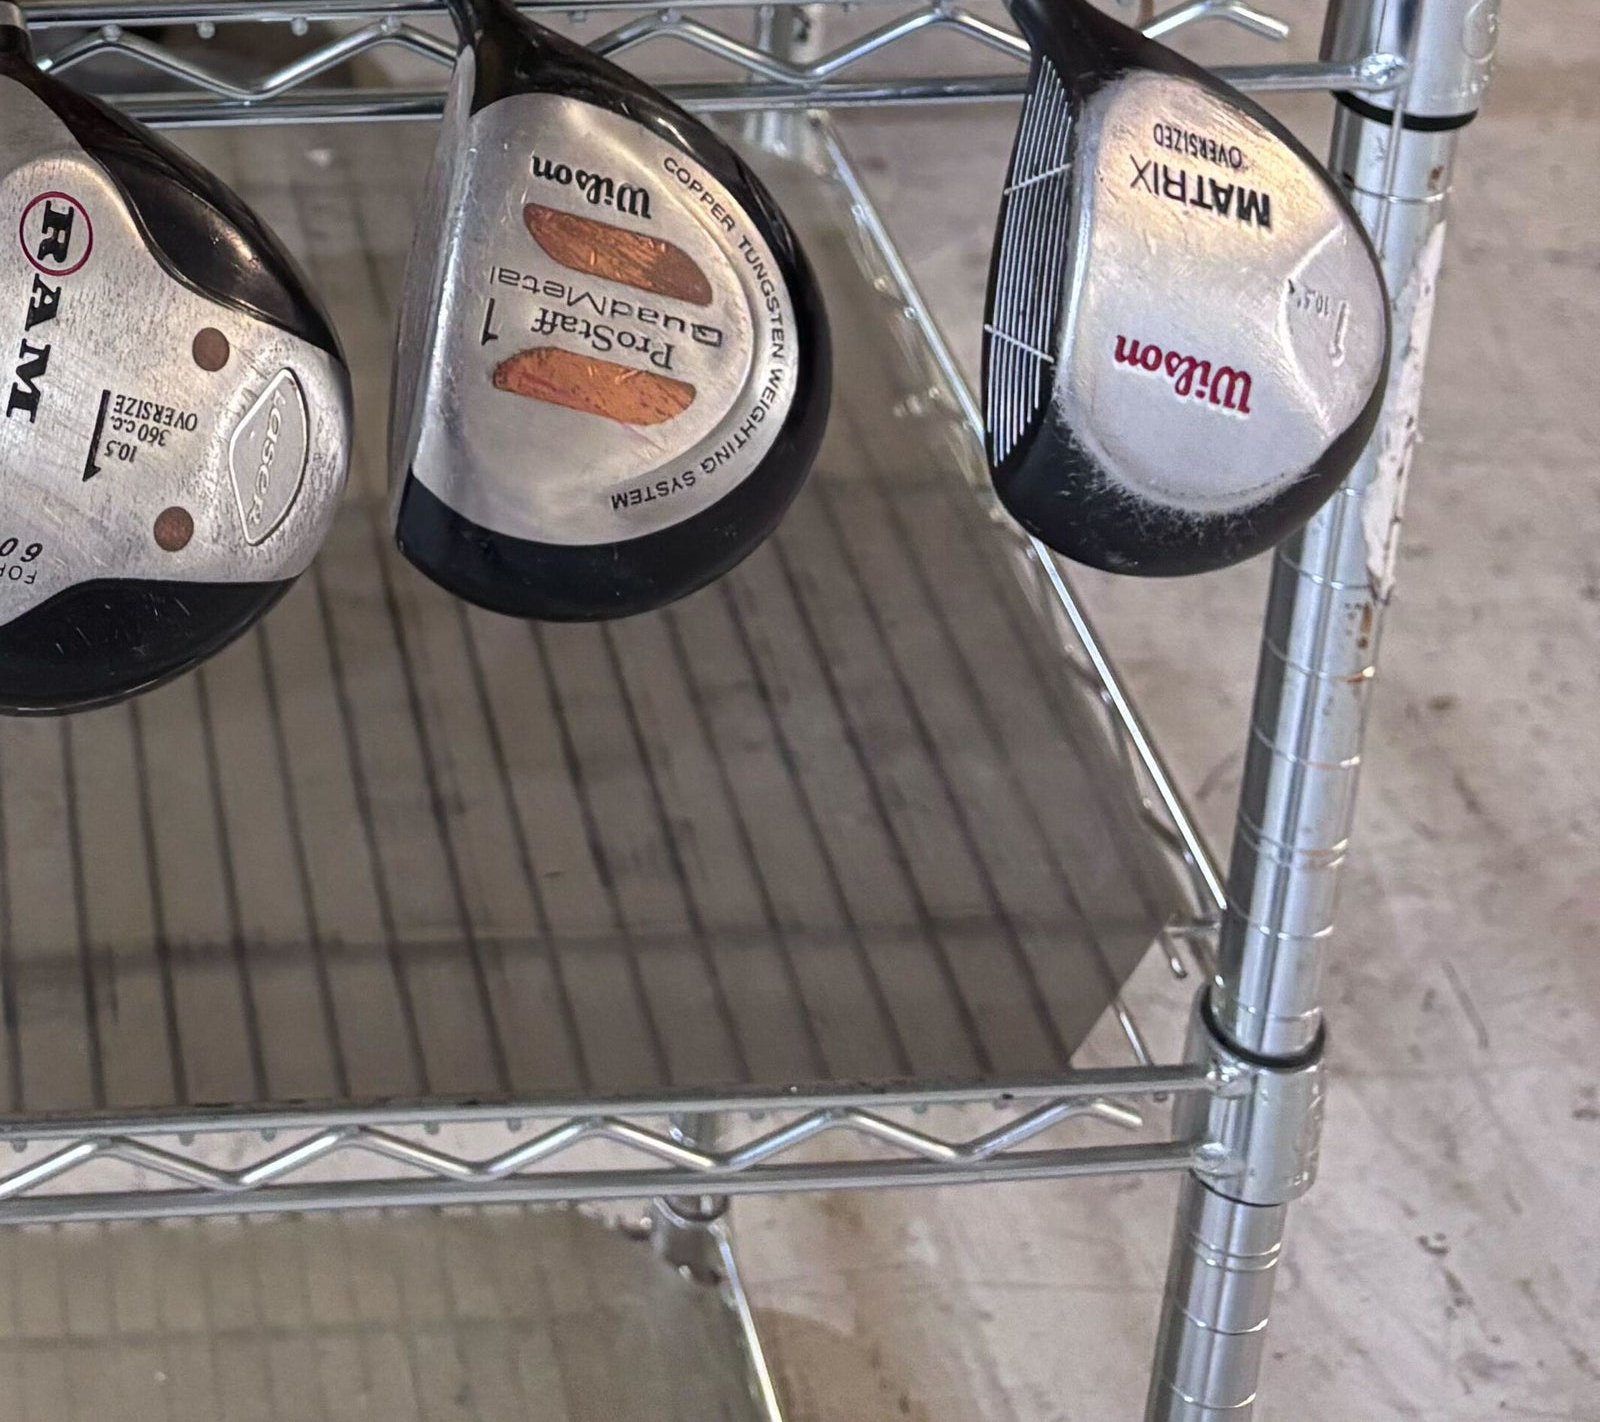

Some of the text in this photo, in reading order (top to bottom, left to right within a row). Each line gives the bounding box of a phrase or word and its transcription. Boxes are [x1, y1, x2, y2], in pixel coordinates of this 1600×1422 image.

[1153, 123, 1244, 169] OVERSIZED
[532, 156, 652, 219] Wilson
[1130, 155, 1271, 229] MATRIX
[6, 200, 75, 424] RAM
[481, 297, 673, 370] ProStaff 1
[490, 265, 723, 348] QuadMetal
[611, 156, 785, 511] COPPER TUNGSTEN WEIGHTING SYSTEM
[1115, 335, 1252, 415] Wilson
[115, 394, 199, 433] OVERSIZE
[137, 426, 172, 447] 360
[103, 440, 138, 463] 10.5
